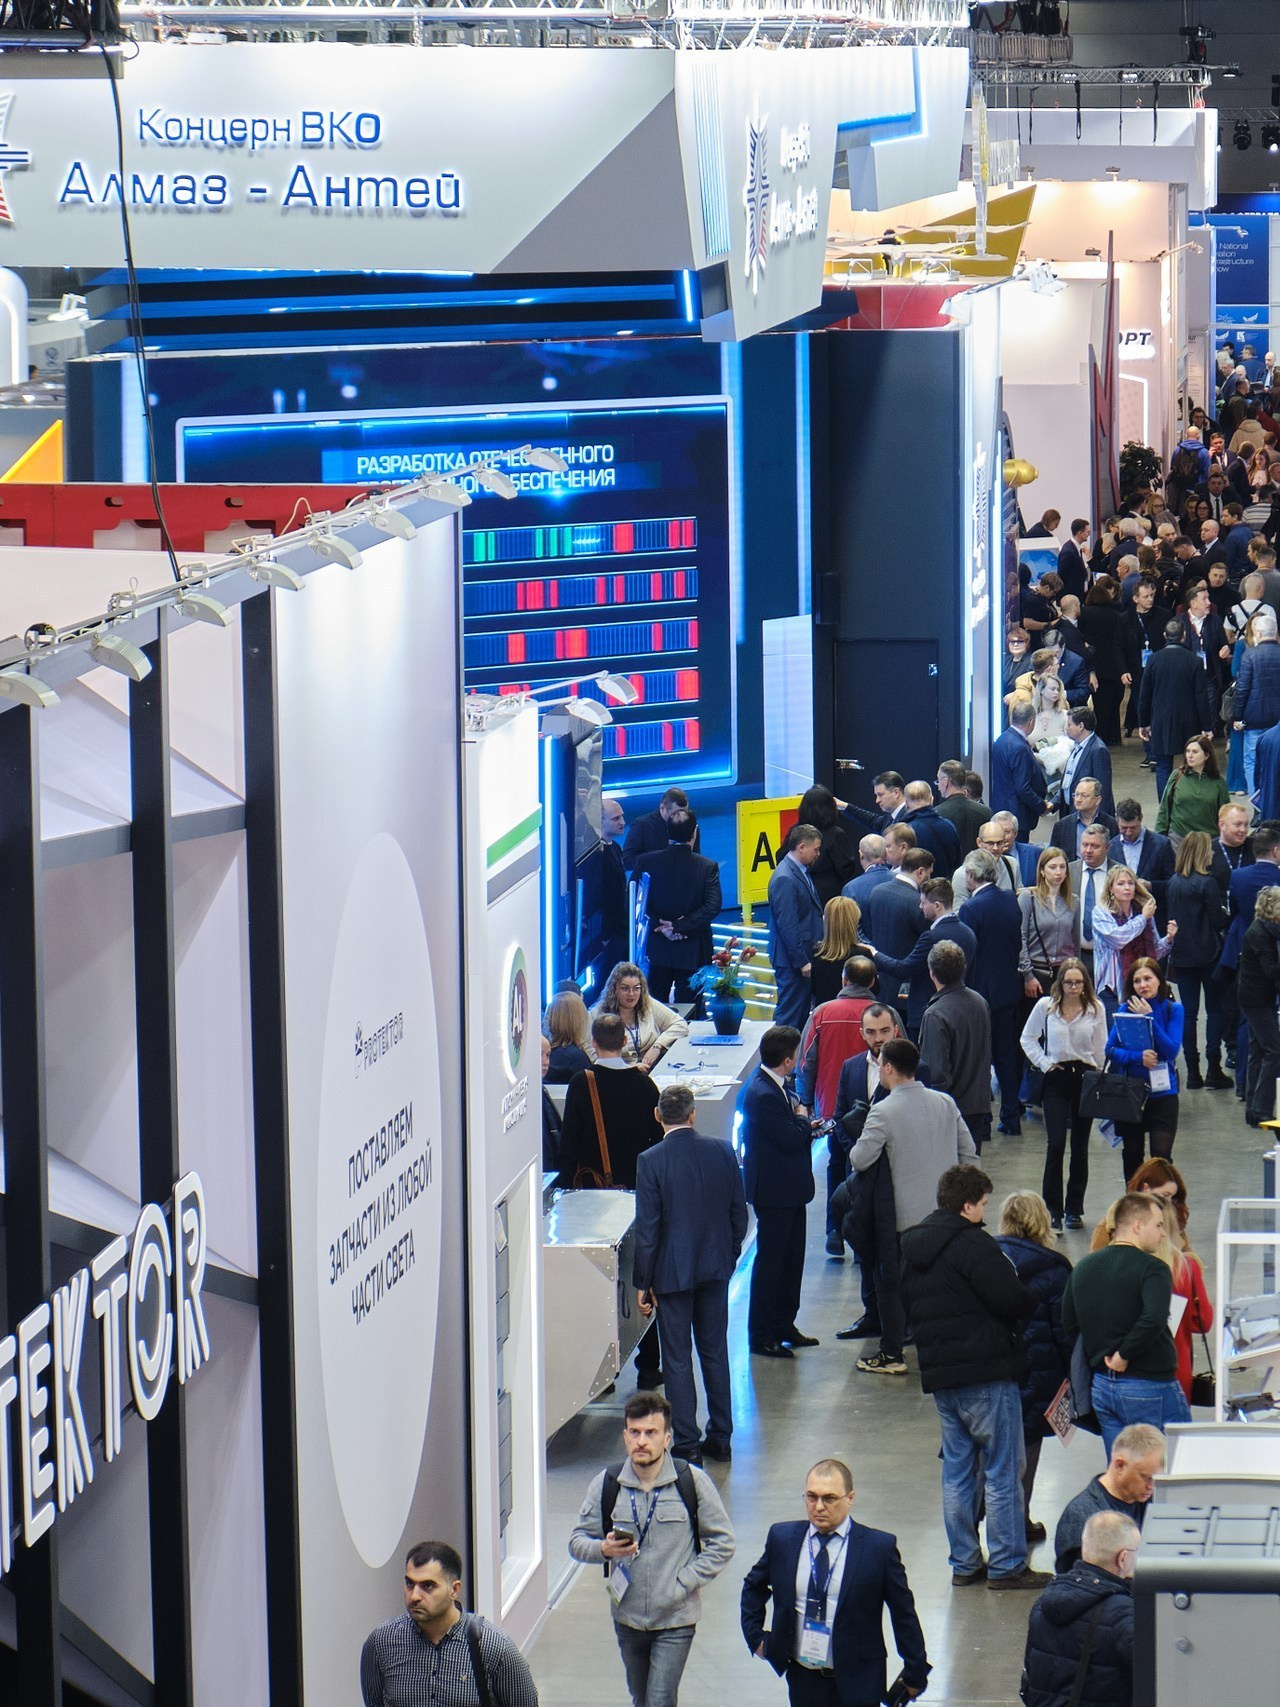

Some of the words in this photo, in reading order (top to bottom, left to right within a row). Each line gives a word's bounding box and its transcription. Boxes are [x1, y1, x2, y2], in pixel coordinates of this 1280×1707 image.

[139, 109, 290, 149] Концерн
[302, 111, 381, 144] ВКО
[60, 162, 227, 205] Алмаз
[283, 164, 461, 208] Антей
[357, 452, 466, 474] РАЗРАБОТКА
[508, 468, 615, 491] БЕСПЕЧЕНИЯ
[364, 1012, 404, 1071] PROTEKTOR
[349, 1101, 414, 1199] ПОСТАВЛЯЕМ
[329, 1196, 381, 1286] ЗАПЧАСТИ
[383, 1182, 396, 1231] ИЗ
[397, 1138, 433, 1216] ЛЮБОЙ
[352, 1257, 384, 1326] ЧАСТИ
[385, 1228, 416, 1290] СВЕТА
